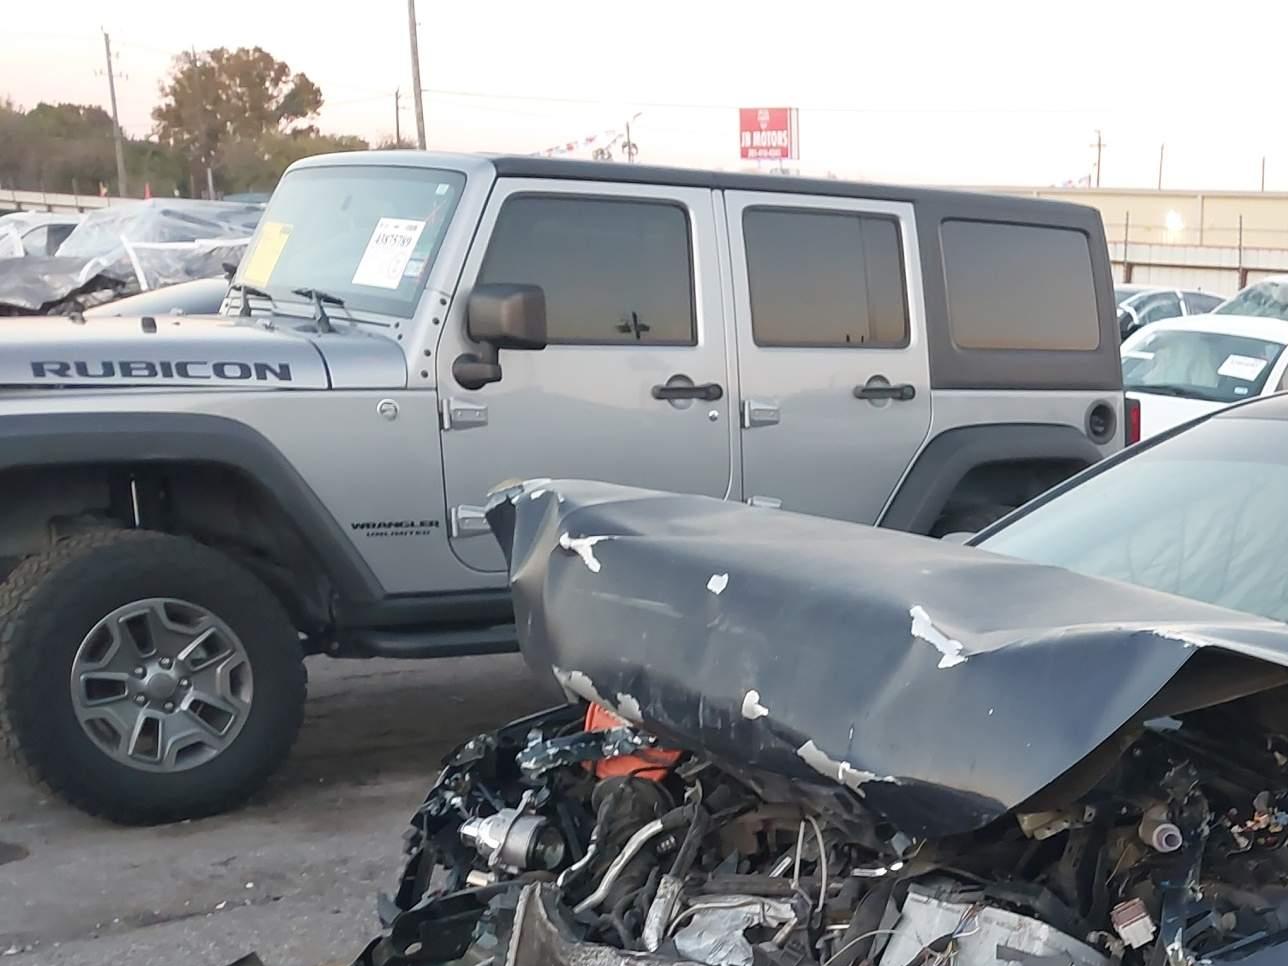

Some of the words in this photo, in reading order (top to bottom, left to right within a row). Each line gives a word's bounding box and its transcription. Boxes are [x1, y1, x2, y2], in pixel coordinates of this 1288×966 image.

[753, 130, 787, 147] MOTORS
[31, 360, 292, 382] RUBICON
[352, 520, 440, 529] WRANGLER
